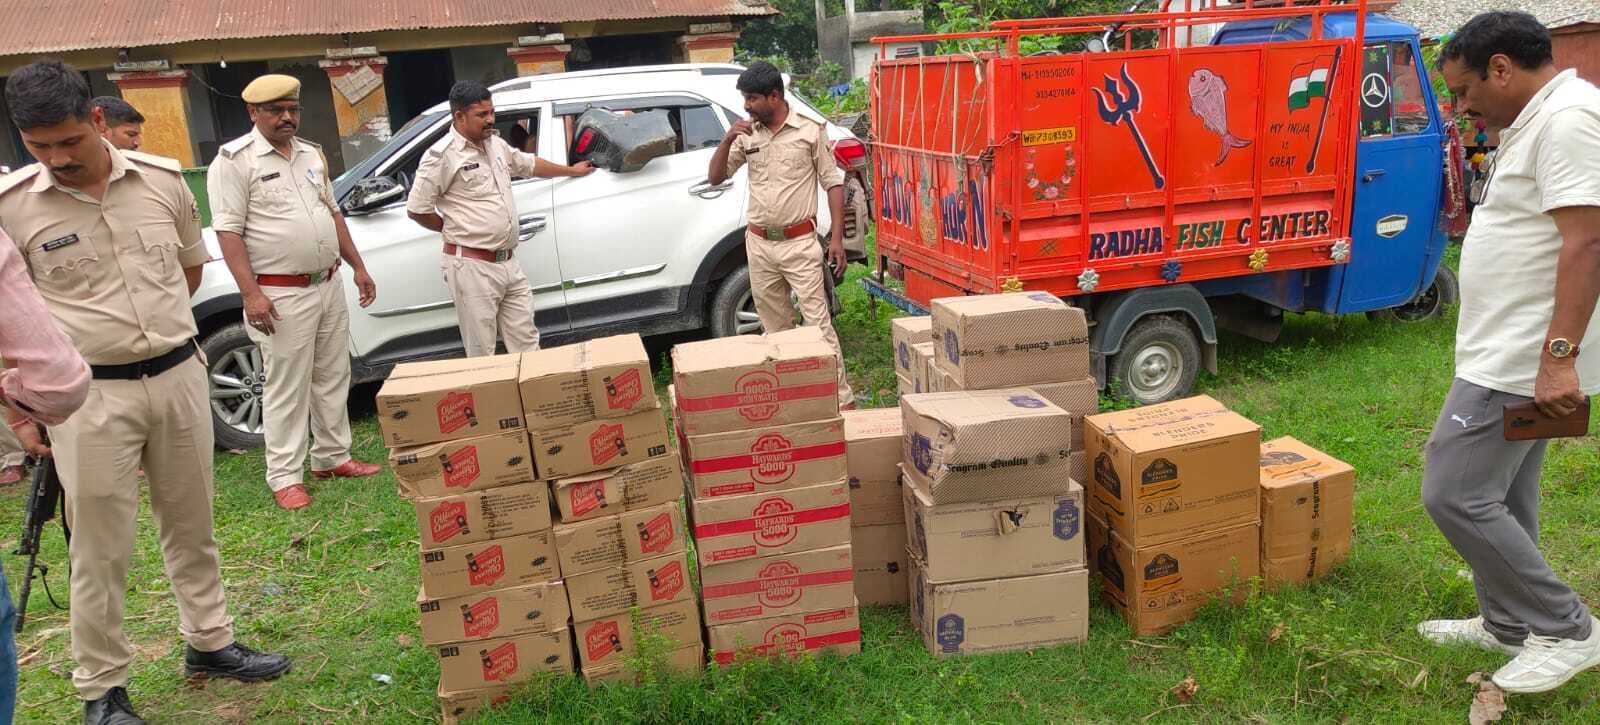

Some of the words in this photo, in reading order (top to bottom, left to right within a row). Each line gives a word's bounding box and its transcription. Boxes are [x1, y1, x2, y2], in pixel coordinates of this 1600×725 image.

[1270, 123, 1283, 134] MY
[1287, 123, 1311, 136] INDIA
[1281, 141, 1289, 150] IS
[1269, 155, 1297, 168] GREAT
[1088, 226, 1164, 261] RADHA
[1175, 220, 1225, 252] FISH
[752, 452, 793, 465] HAYWARDS
[759, 461, 785, 473] 5000
[946, 463, 987, 473] Seagram
[755, 515, 795, 528] HAYWARDS
[763, 525, 788, 536] 5000
